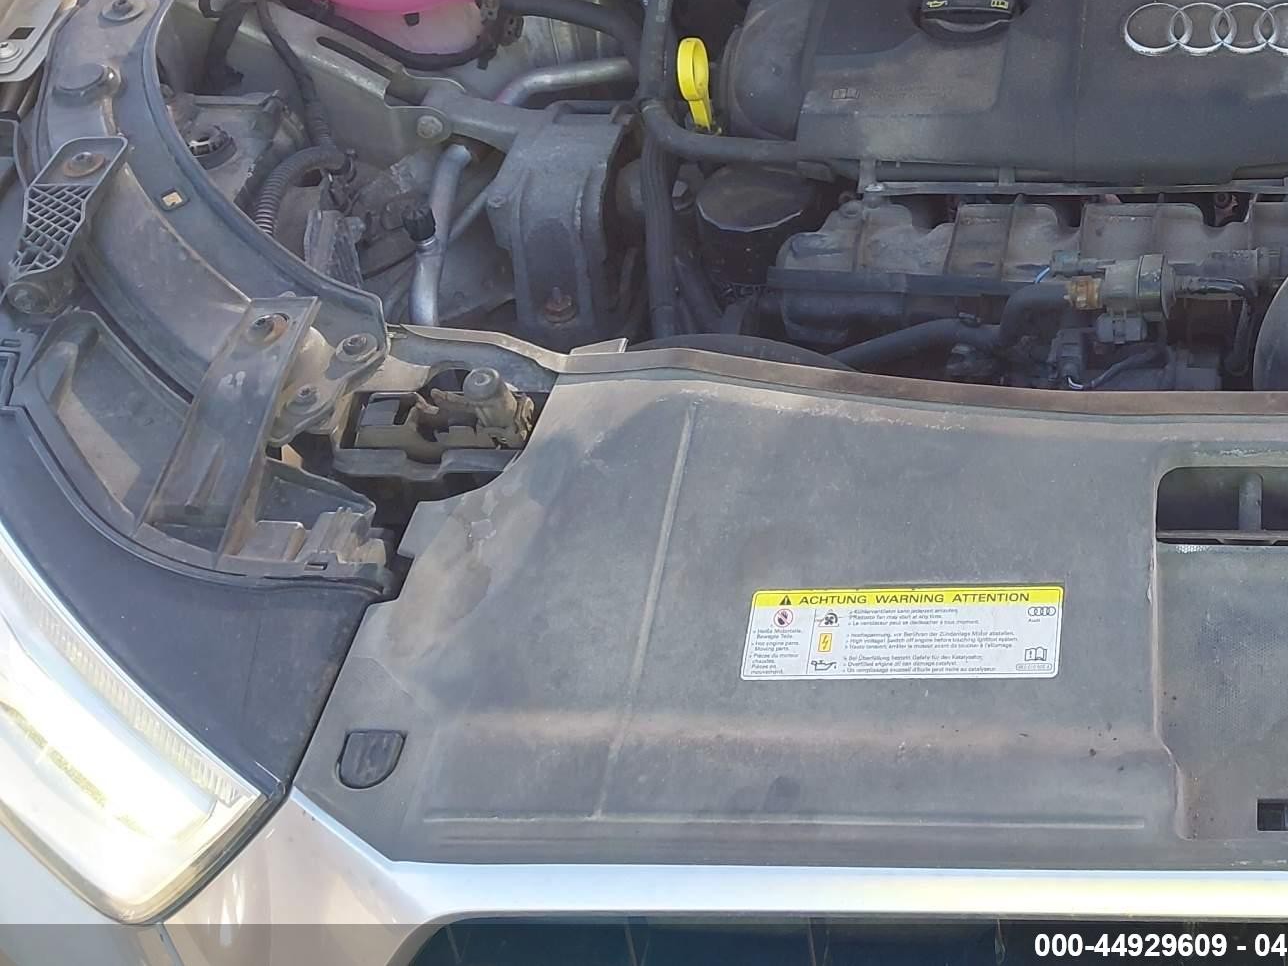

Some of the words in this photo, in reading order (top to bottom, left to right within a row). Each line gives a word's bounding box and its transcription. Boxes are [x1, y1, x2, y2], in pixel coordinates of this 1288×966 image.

[799, 595, 867, 605] ACHTUNG
[876, 594, 944, 604] WARNING
[952, 593, 1030, 603] ATTENTION
